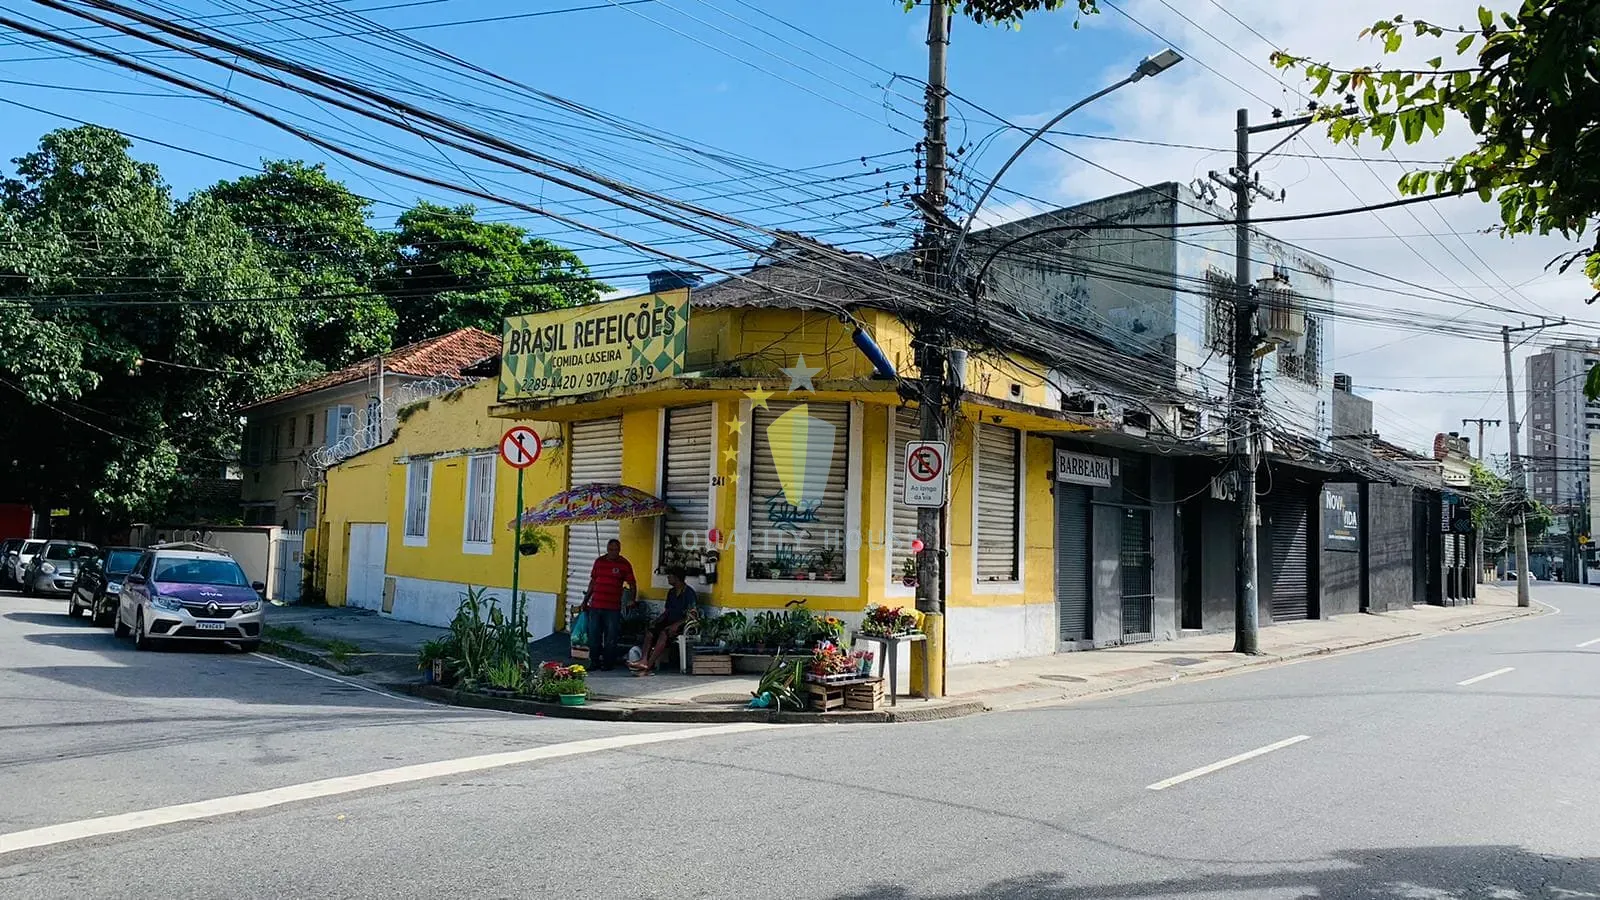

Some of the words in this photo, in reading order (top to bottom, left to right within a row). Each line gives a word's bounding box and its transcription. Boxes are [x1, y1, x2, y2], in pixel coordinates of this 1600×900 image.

[509, 323, 567, 355] BRASIL
[573, 303, 676, 349] REFEIÇÕES
[552, 354, 583, 368] COMIDA
[585, 349, 622, 365] CASEIRA
[521, 374, 576, 392] 2289-4420
[1060, 456, 1110, 480] BARBEARIA
[711, 476, 725, 486] 241
